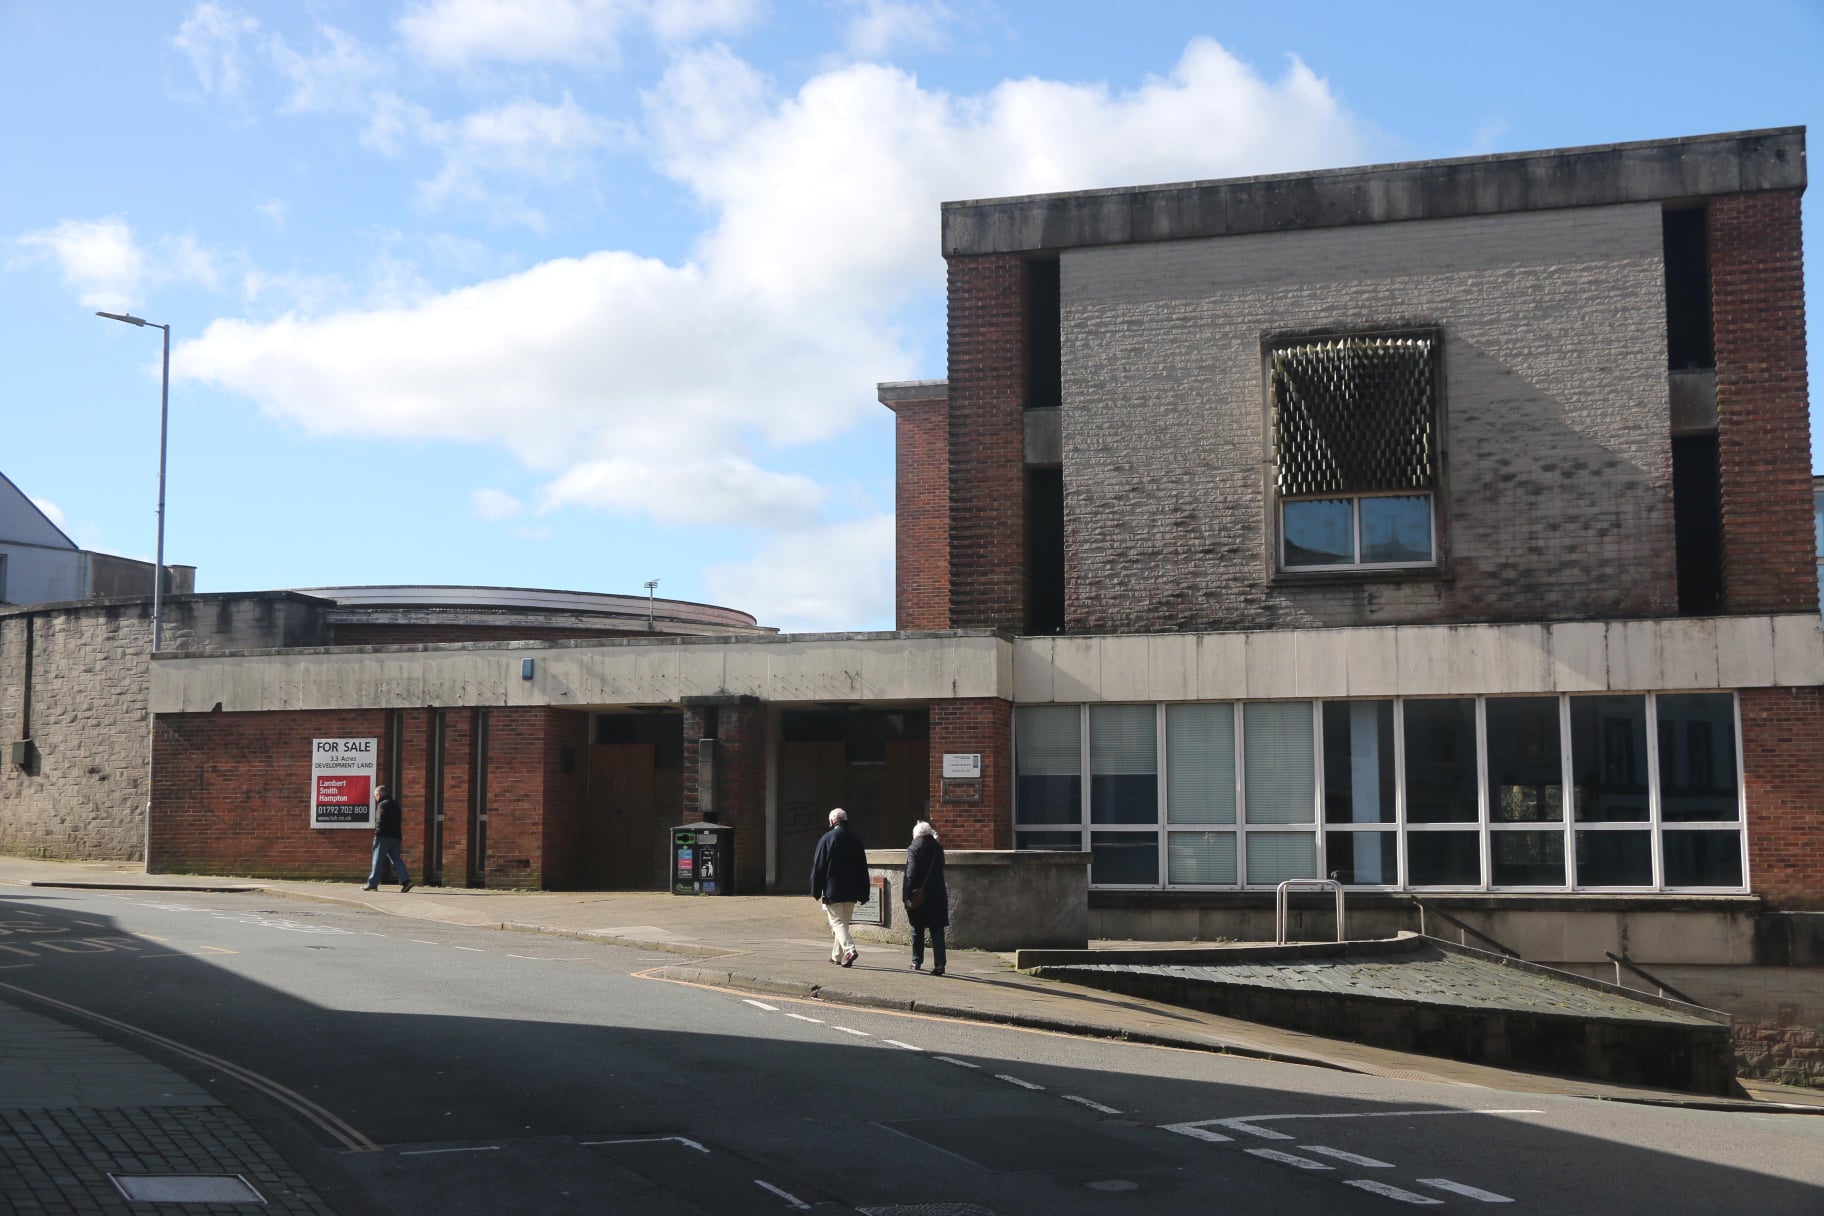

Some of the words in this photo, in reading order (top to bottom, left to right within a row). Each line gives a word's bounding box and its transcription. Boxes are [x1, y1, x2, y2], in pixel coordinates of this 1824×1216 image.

[317, 742, 339, 752] FOR
[343, 742, 371, 752] SALE
[318, 806, 339, 814] 01792
[341, 806, 353, 814] 702
[354, 806, 368, 814] 800
[0, 937, 142, 957] TOP
